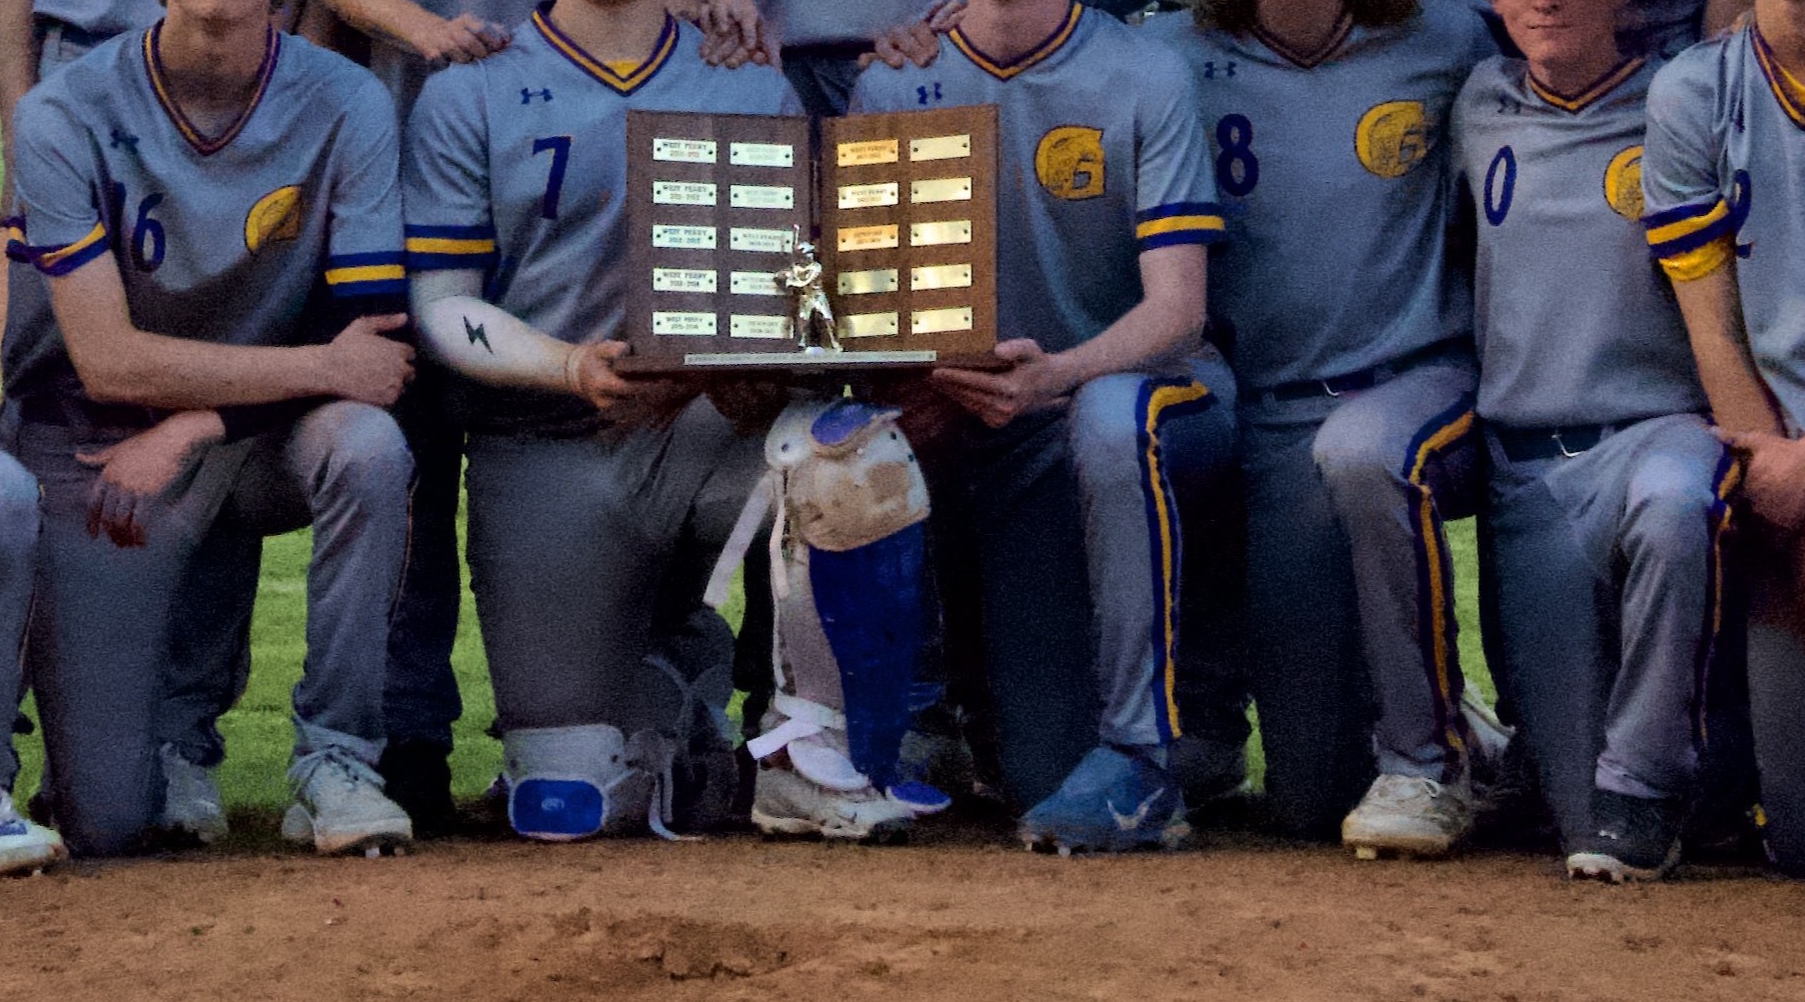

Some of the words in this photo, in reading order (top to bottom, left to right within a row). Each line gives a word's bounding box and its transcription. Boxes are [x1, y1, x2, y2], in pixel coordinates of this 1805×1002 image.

[533, 135, 573, 219] 7
[1216, 113, 1259, 197] 8
[1484, 145, 1516, 227] 0
